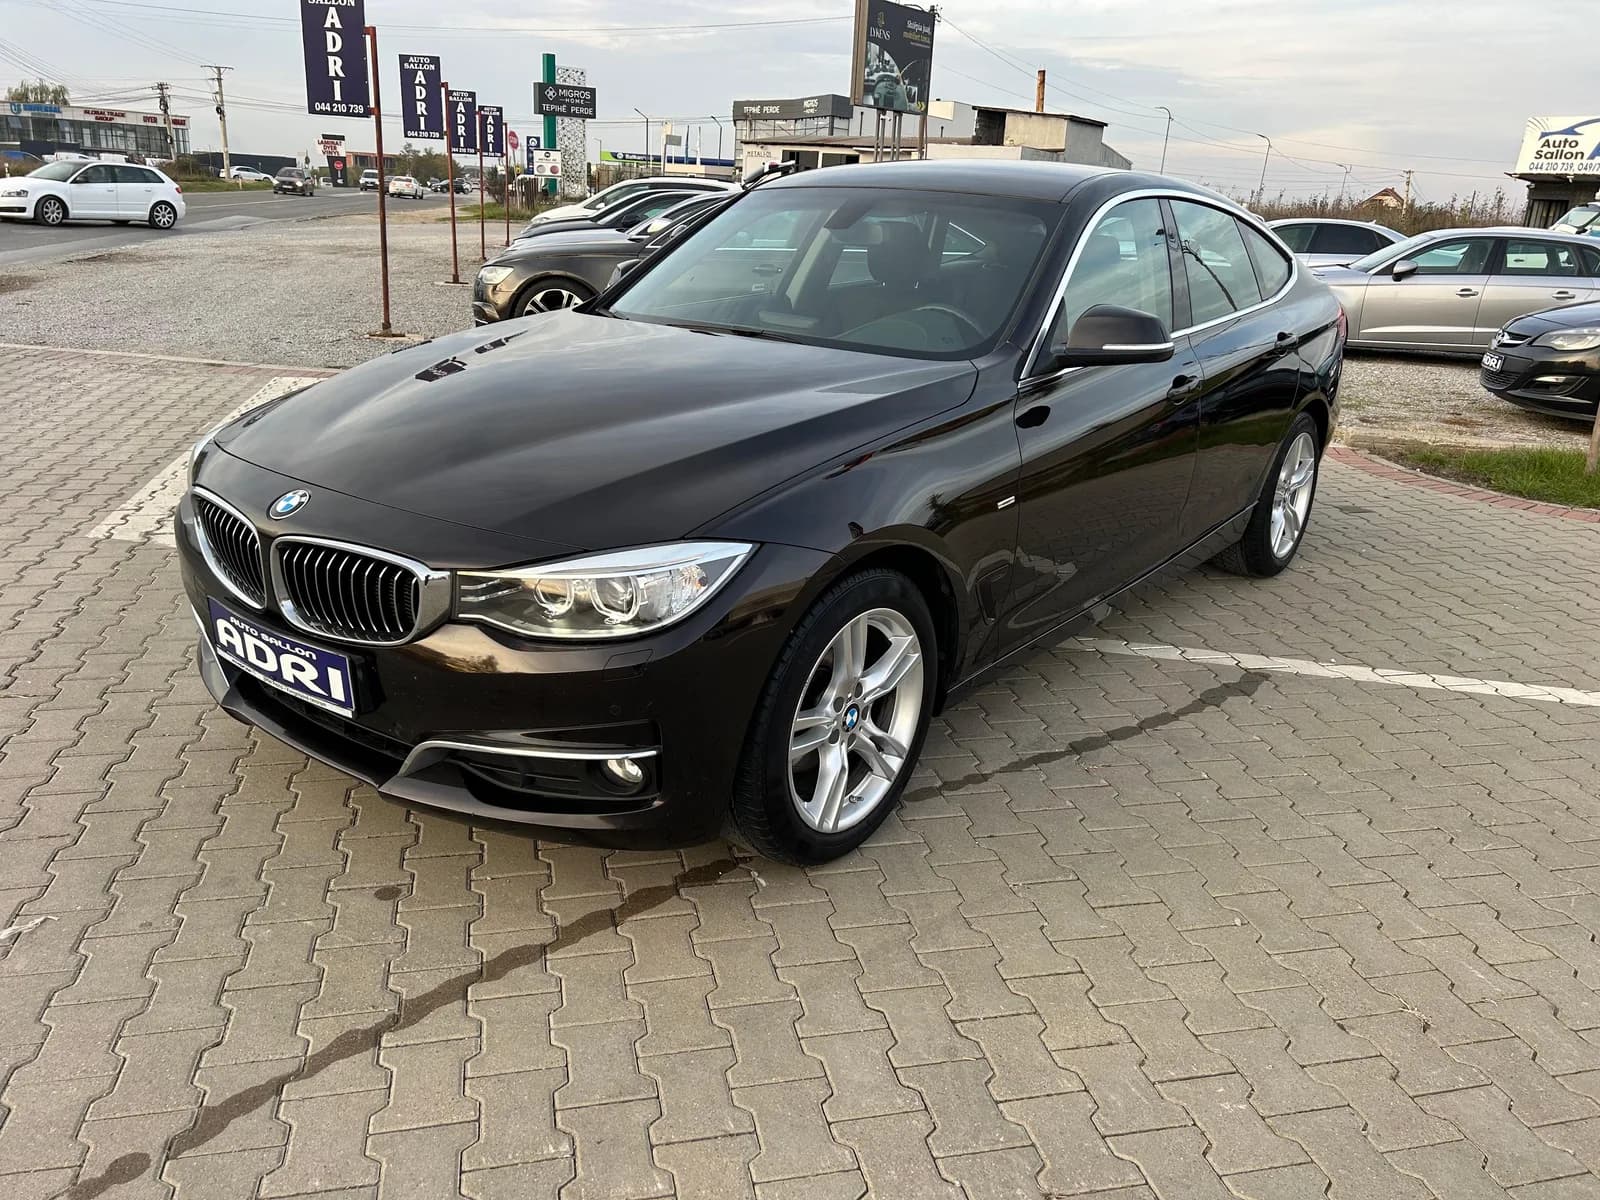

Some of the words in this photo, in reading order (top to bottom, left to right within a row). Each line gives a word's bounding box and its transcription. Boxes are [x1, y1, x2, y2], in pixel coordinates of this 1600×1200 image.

[323, 6, 346, 101] ADRI
[414, 70, 428, 130] ADRI
[558, 89, 591, 99] MIGROS
[314, 102, 331, 112] 044
[332, 103, 347, 113] 210
[349, 104, 364, 114] 739
[571, 106, 593, 115] PERDE
[456, 102, 466, 147] ADRI
[486, 116, 494, 152] ADRI
[1534, 149, 1585, 160] Sallon
[1540, 138, 1579, 148] Auto
[1528, 162, 1544, 171] 044
[1545, 162, 1559, 171] 210
[229, 616, 258, 636] AUTO
[260, 633, 317, 660] SALLON
[216, 618, 346, 702] ADRI
